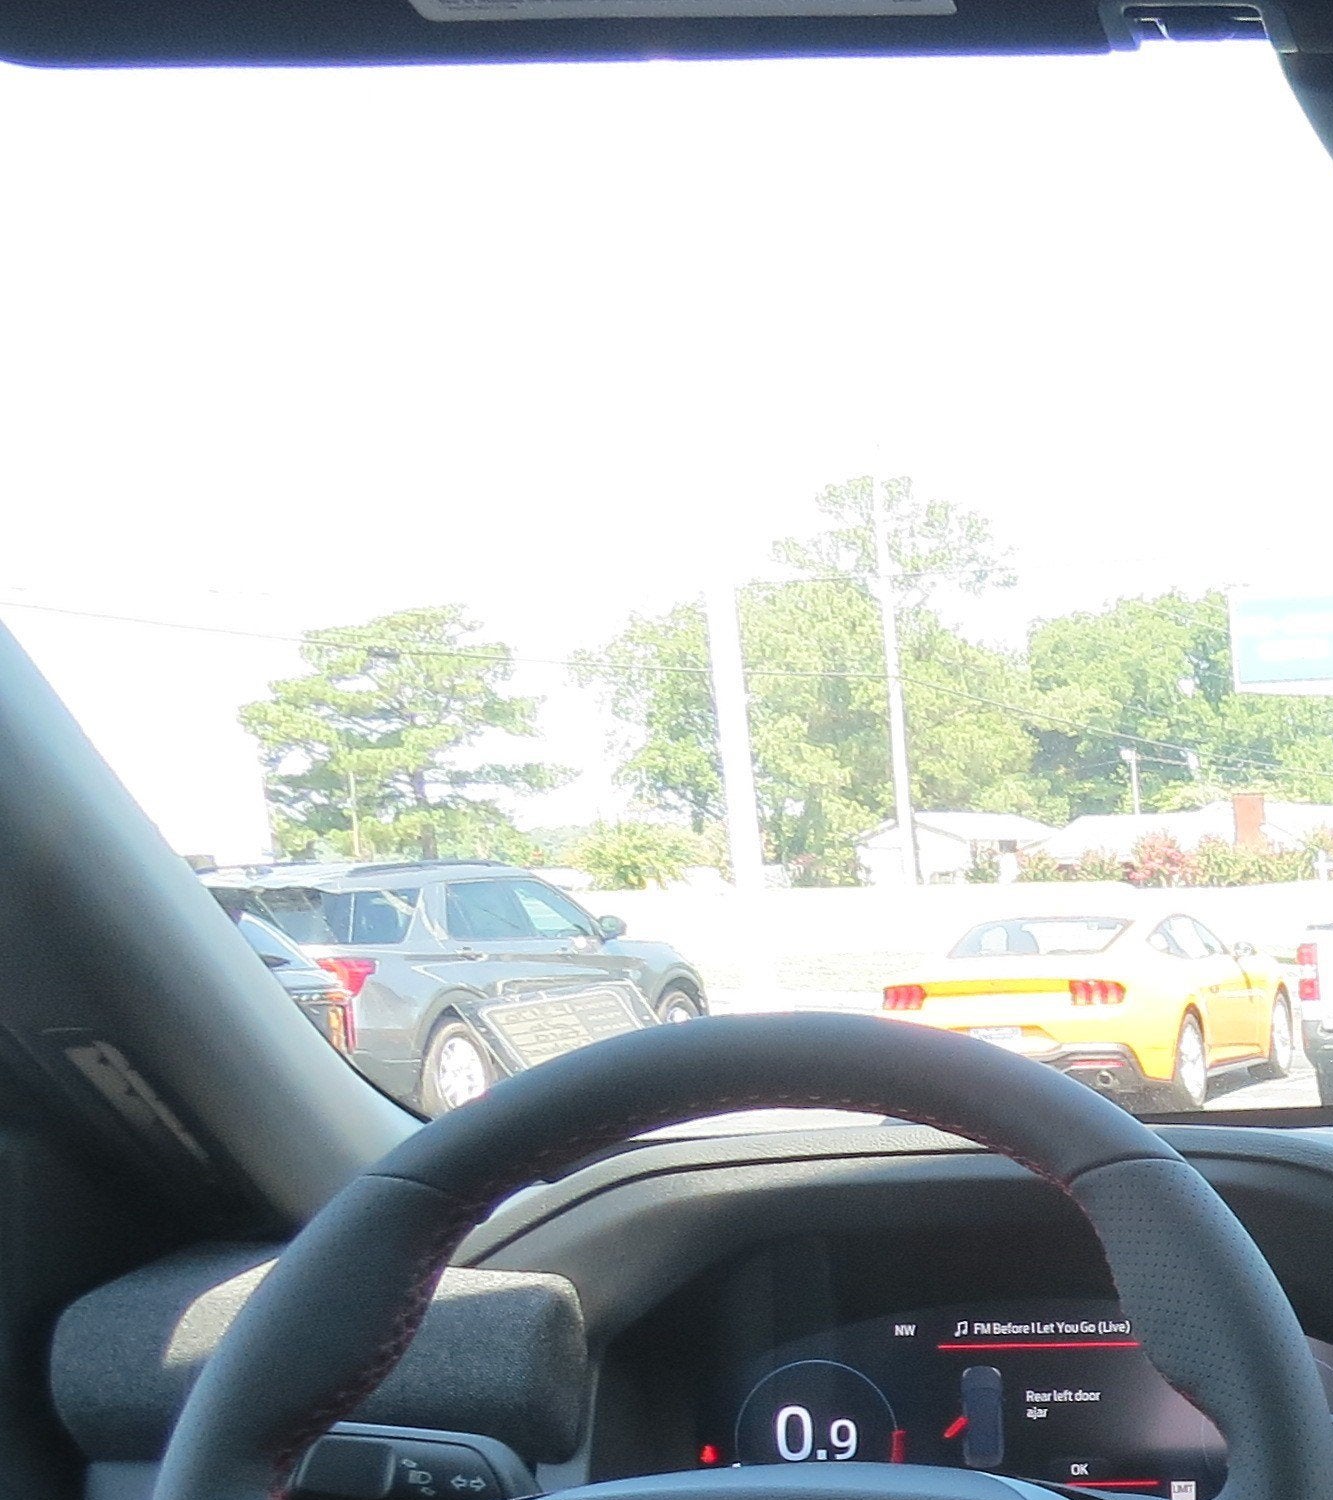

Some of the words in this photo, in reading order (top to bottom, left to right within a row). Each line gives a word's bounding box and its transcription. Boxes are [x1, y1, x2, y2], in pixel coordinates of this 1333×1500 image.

[894, 1324, 916, 1337] NW
[973, 1322, 991, 1335] FM
[993, 1321, 1030, 1335] Before
[1037, 1322, 1054, 1334] Let
[1055, 1321, 1079, 1334] You
[1080, 1321, 1096, 1334] Go
[1098, 1320, 1131, 1334] (Live)
[1026, 1390, 1052, 1402] Rear
[1053, 1389, 1073, 1402] left
[1074, 1389, 1100, 1402] door
[1026, 1407, 1048, 1419] ajar
[775, 1404, 858, 1462] 0.9
[1070, 1462, 1089, 1476] OK
[1172, 1484, 1193, 1493] LIMIT
